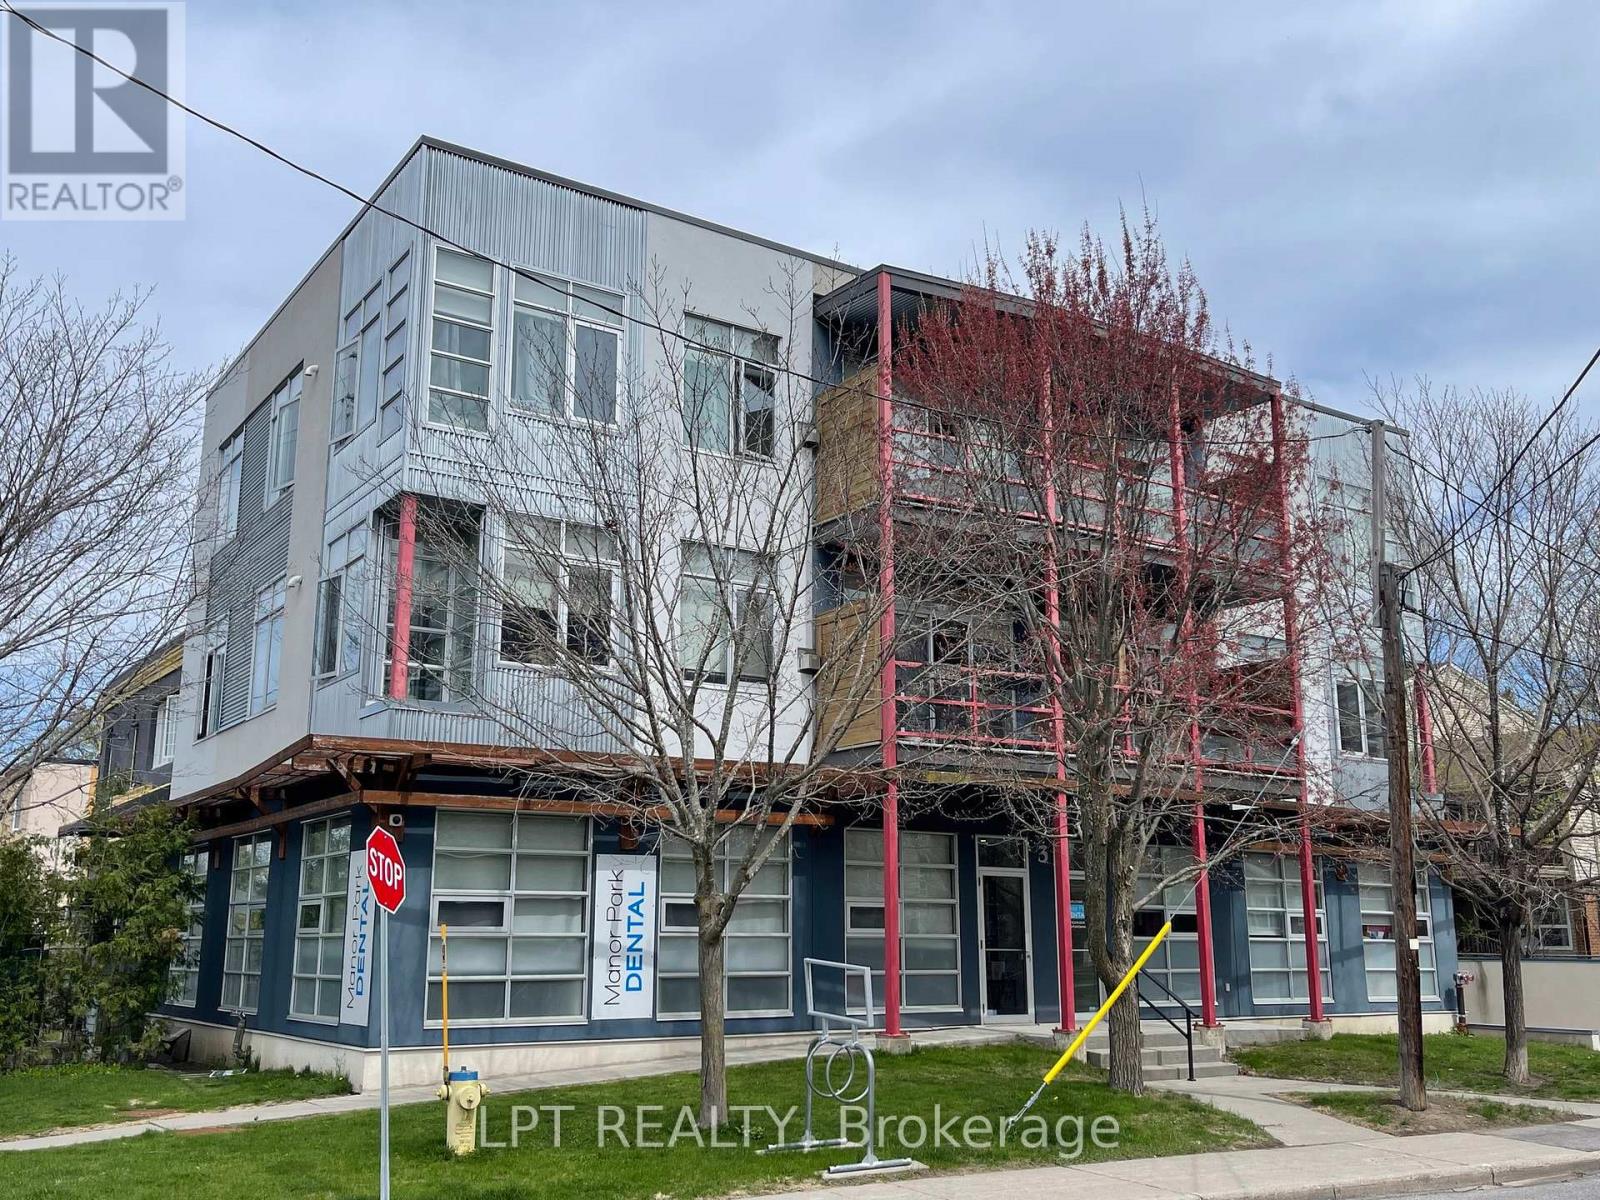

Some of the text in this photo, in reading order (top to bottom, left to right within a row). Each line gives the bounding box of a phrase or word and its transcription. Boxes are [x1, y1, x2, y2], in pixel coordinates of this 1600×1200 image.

[369, 847, 403, 890] STOP
[346, 865, 363, 1009] Manor Park
[356, 879, 370, 996] DENTAL
[604, 869, 624, 1006] Manor Park
[625, 881, 645, 992] DENTAL
